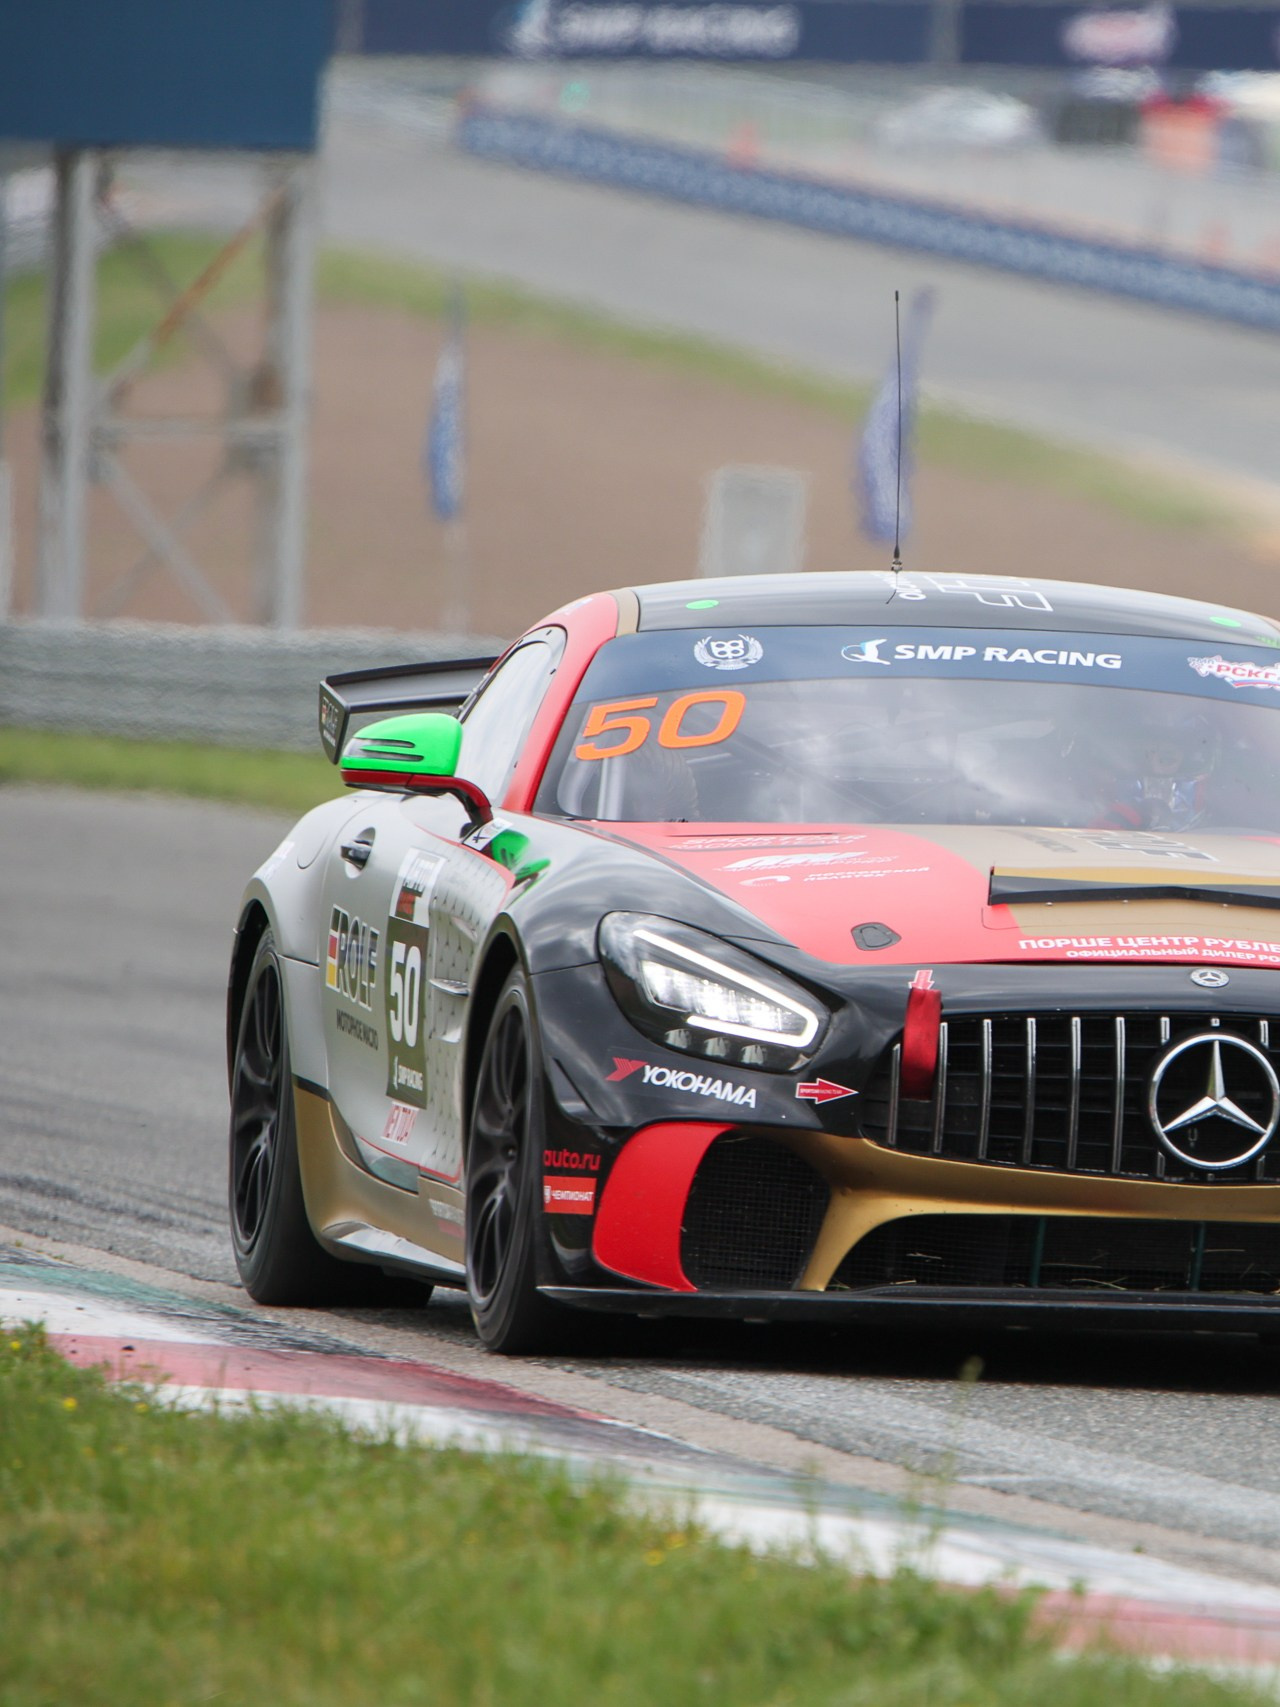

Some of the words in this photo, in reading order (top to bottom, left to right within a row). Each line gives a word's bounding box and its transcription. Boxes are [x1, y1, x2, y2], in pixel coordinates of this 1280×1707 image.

[893, 644, 977, 661] SMP
[982, 646, 1123, 670] RACING
[1216, 663, 1277, 680] РСКГ
[575, 689, 747, 761] 50
[1018, 937, 1114, 950] ПОРШЕ
[1115, 935, 1199, 949] ЦЕНТР
[1066, 948, 1199, 958] ОФИЦИАЛЬНЫЙ
[1202, 949, 1257, 961] ДИЛЕР
[332, 904, 380, 1012] ROLF
[390, 940, 422, 1048] 50
[642, 1064, 757, 1109] YOKOHAMA
[543, 1148, 601, 1171] auto.ru
